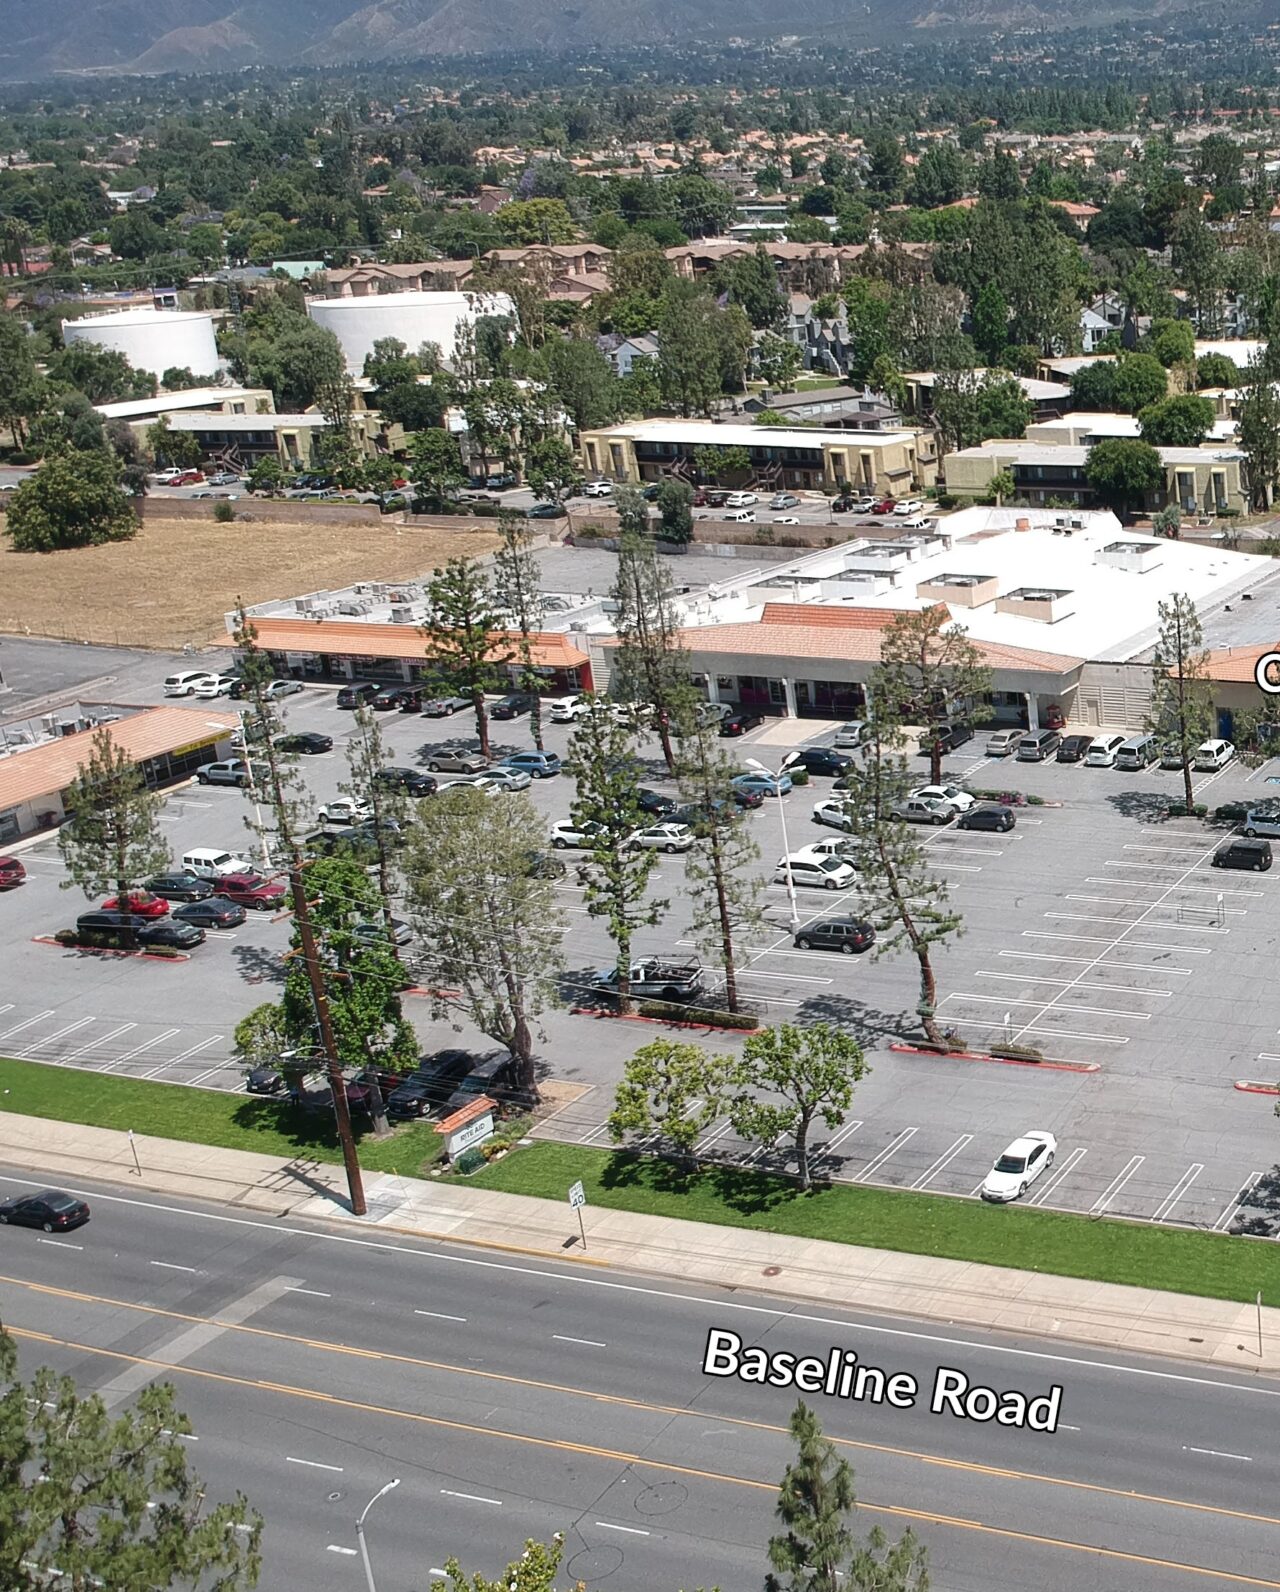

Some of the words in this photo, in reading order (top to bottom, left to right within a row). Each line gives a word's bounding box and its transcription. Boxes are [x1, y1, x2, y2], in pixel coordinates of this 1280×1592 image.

[460, 1129, 474, 1141] RITE
[475, 1122, 485, 1134] AID
[572, 1194, 583, 1207] 40
